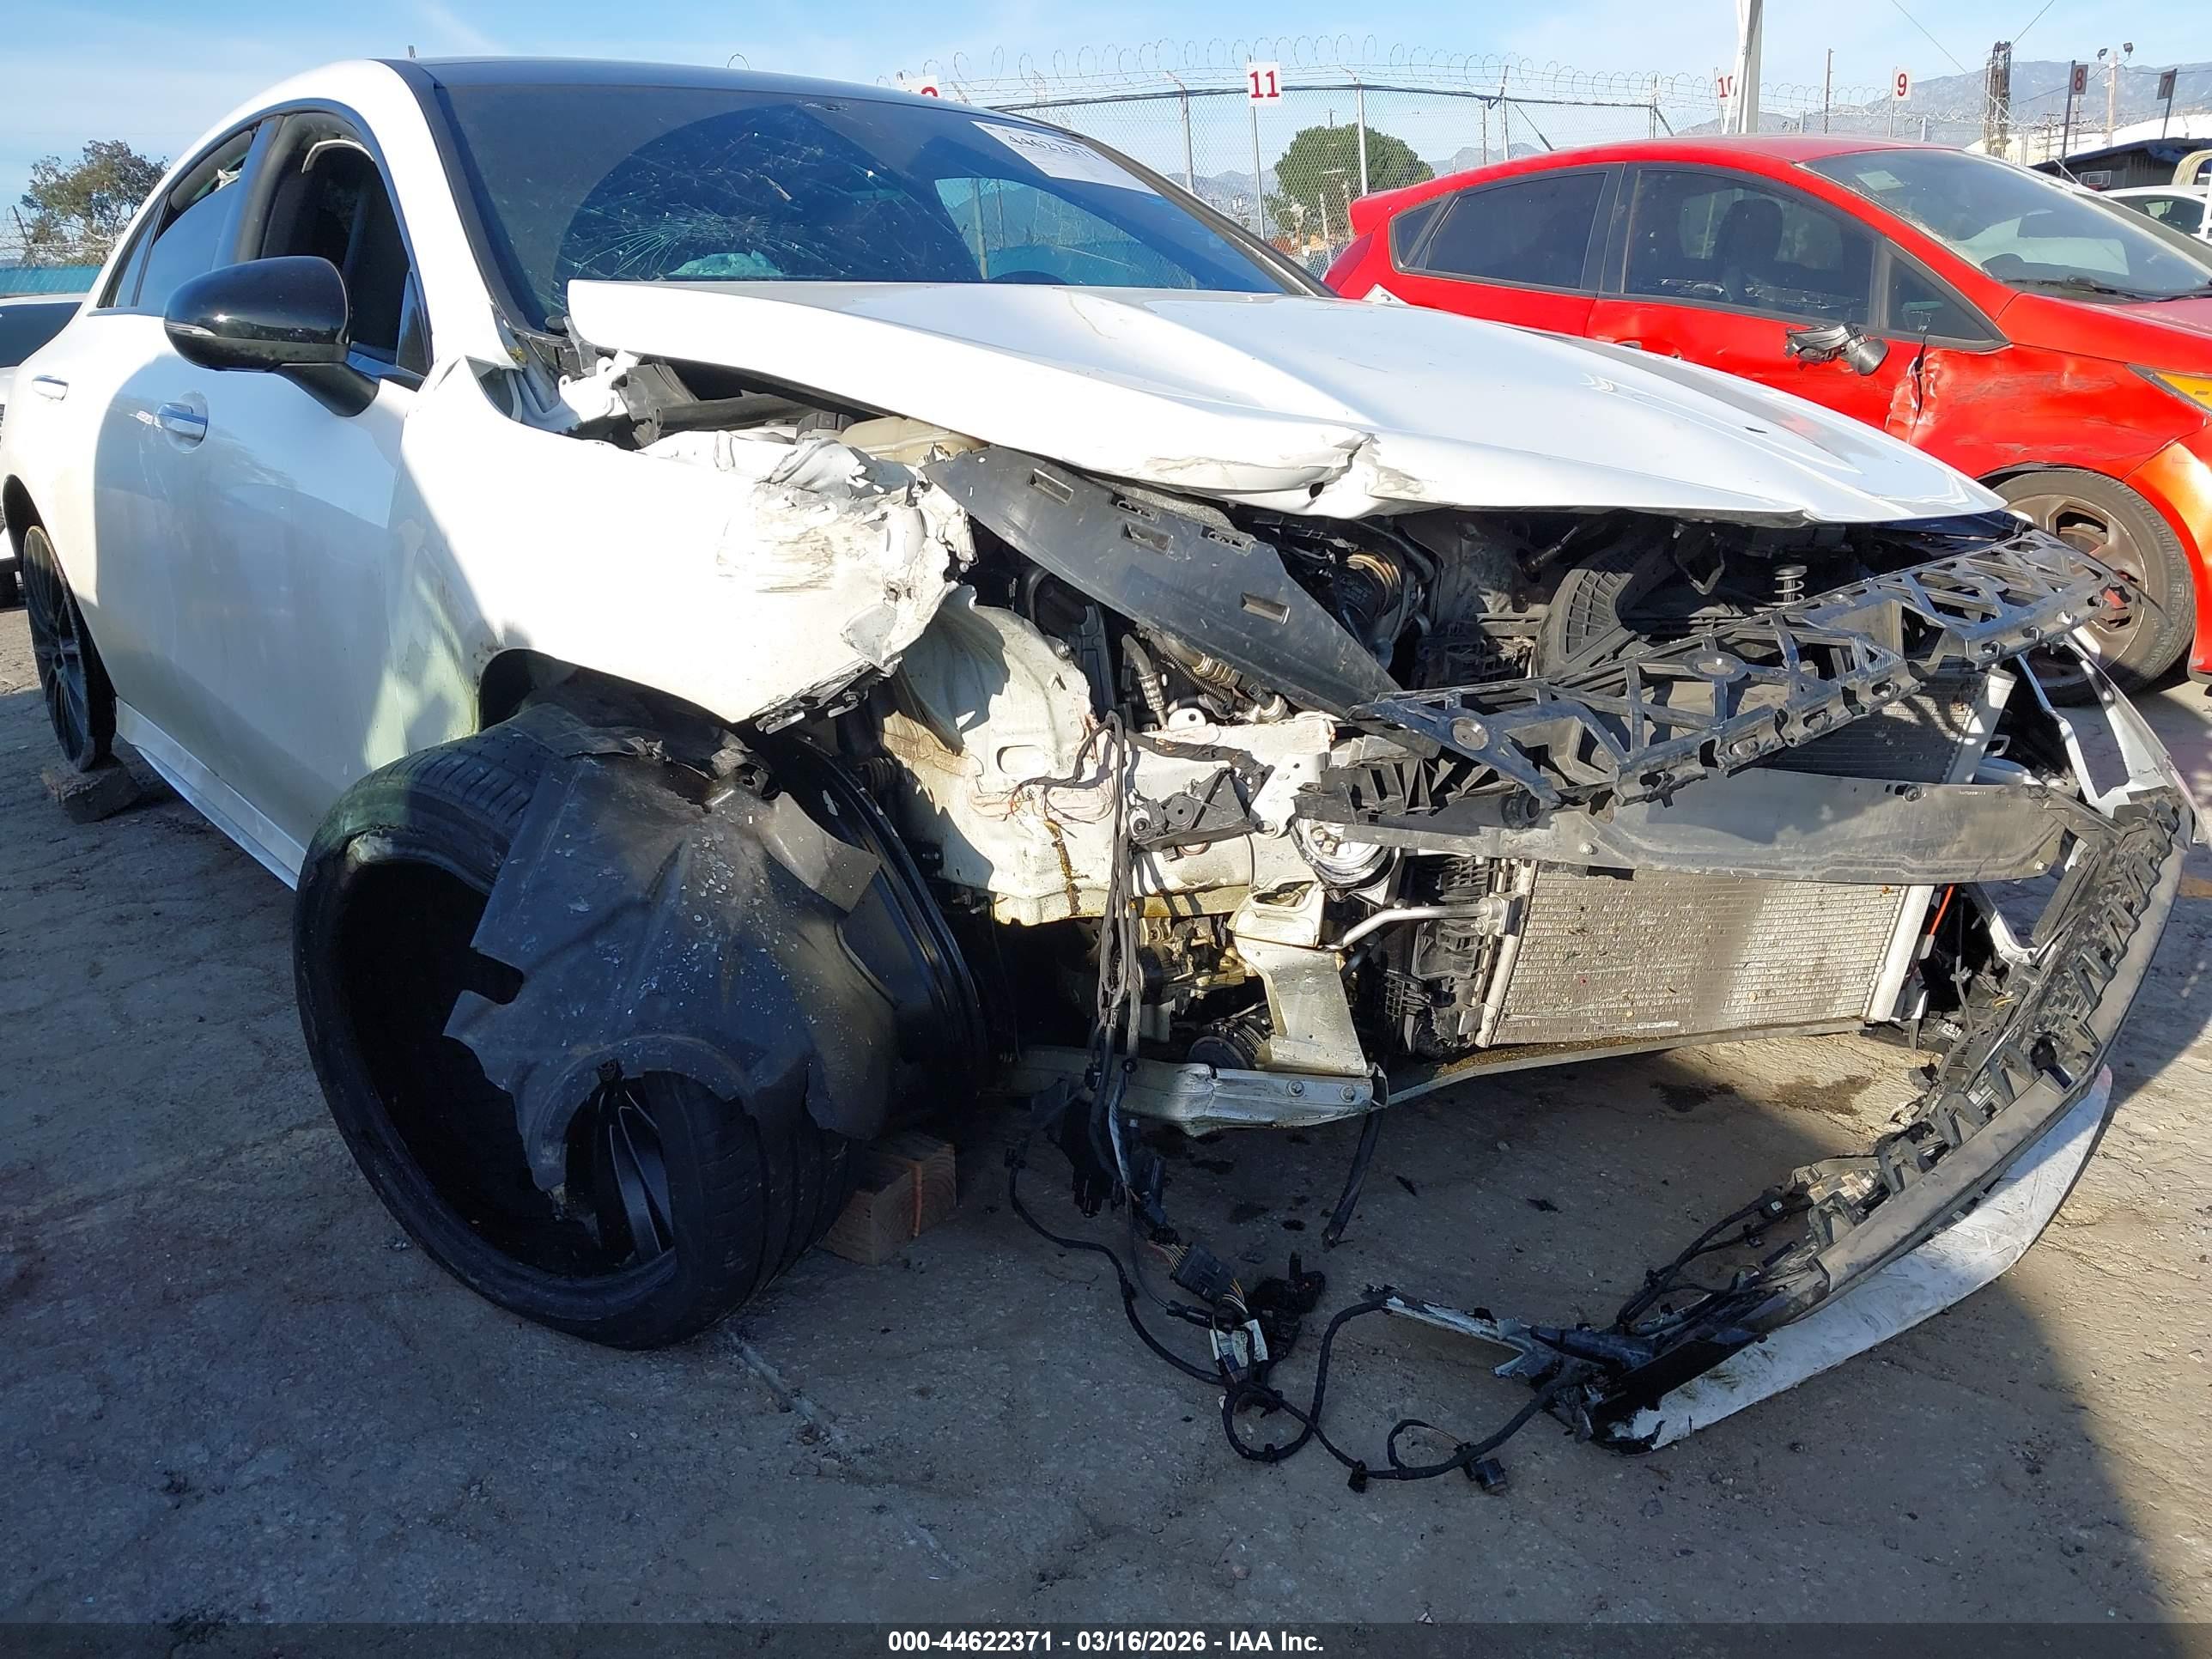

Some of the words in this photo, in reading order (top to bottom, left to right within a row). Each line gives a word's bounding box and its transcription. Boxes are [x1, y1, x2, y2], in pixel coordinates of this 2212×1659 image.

[1249, 70, 1279, 98] 11
[1898, 73, 1907, 96] 9
[2075, 68, 2084, 91] 8
[2162, 75, 2172, 96] 7
[1008, 135, 1100, 161] 44622371
